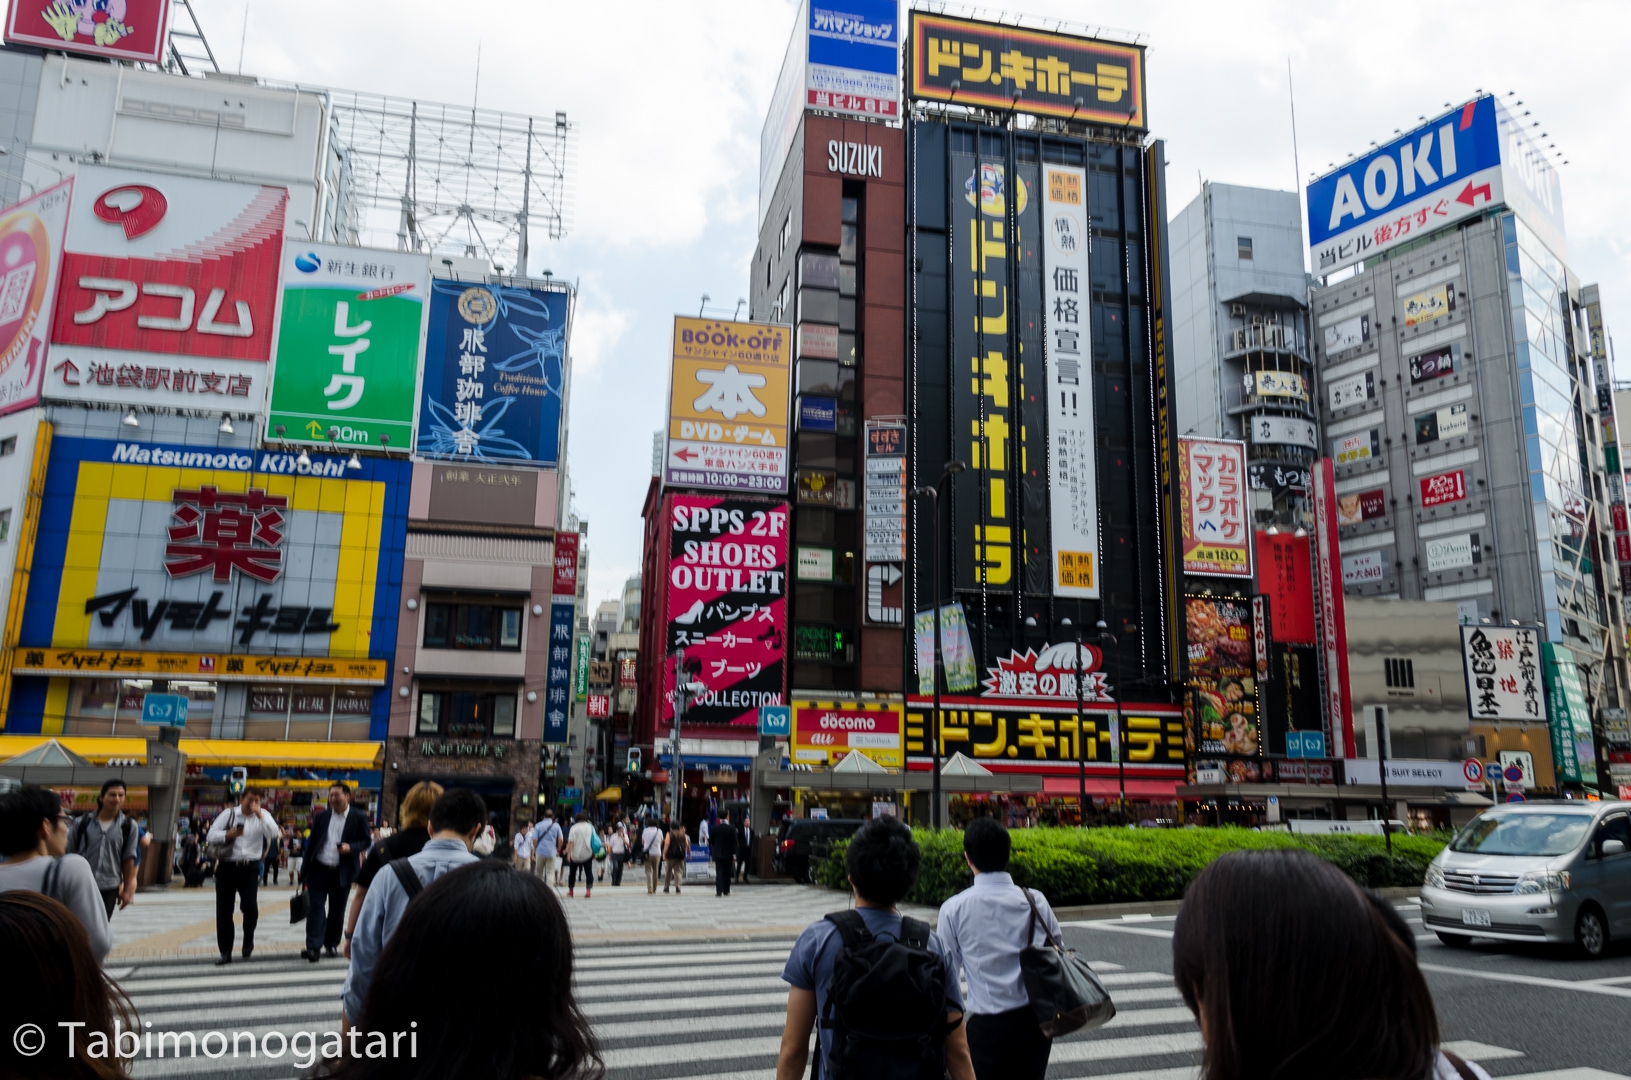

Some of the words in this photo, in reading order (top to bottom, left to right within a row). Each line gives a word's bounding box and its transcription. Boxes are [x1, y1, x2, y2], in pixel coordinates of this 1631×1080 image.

[814, 14, 892, 39] アパマンショップ
[828, 139, 882, 178] SUZUKI
[1328, 122, 1457, 231] AOKI
[326, 258, 396, 281] 新生銀行
[74, 276, 254, 338] アコム
[323, 300, 373, 410] レイク
[684, 345, 780, 363] サンシャイン60通り店
[87, 360, 254, 397] 池袋駅前支店
[493, 384, 520, 396] Coffee
[521, 385, 548, 397] House
[499, 371, 549, 386] Traditional
[693, 363, 768, 421] 本
[113, 443, 253, 471] Matsumoto
[701, 444, 783, 462] サンシャイン60通り
[1193, 454, 1216, 514] マック
[1218, 454, 1240, 540] カラオケ
[673, 505, 745, 535] SPPS
[750, 510, 786, 537] 2F
[683, 540, 777, 568] SHOES
[671, 565, 784, 594] OUTLET
[85, 586, 340, 645] マツモトキヨシ
[706, 601, 774, 623] パンプス
[675, 630, 753, 648] スニーカー
[710, 659, 761, 679] ブーツ
[1496, 638, 1519, 694] 築地
[1516, 629, 1540, 717] 江戸前寿司
[820, 712, 876, 731] docomo
[811, 732, 835, 745] au
[1392, 768, 1410, 778] SUIT
[1411, 768, 1443, 779] SELECT
